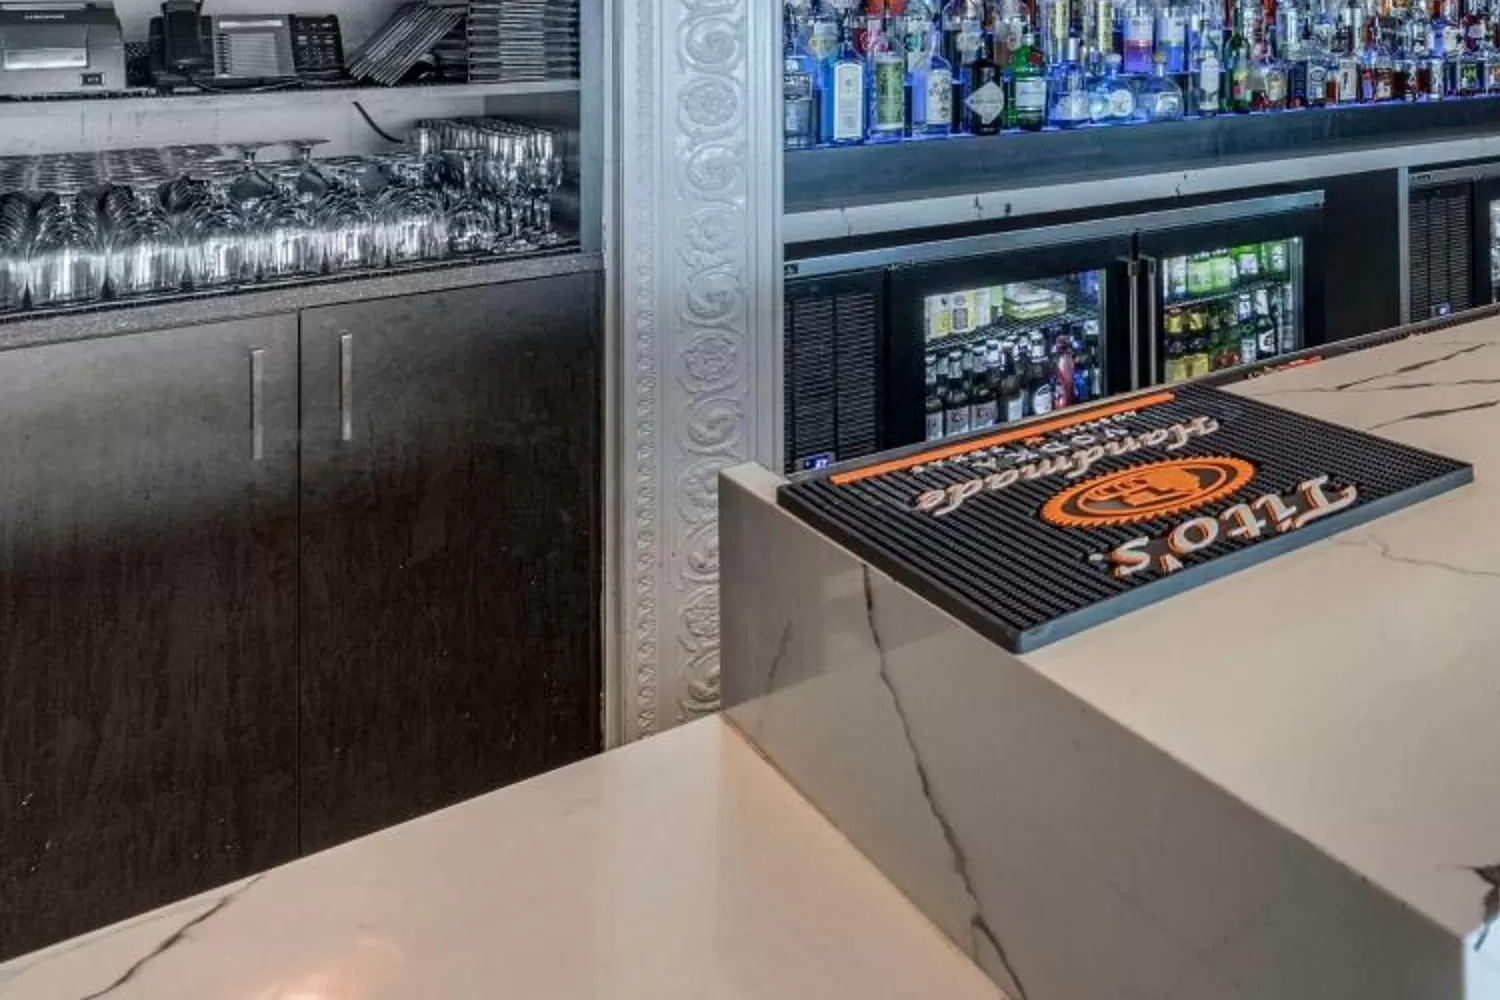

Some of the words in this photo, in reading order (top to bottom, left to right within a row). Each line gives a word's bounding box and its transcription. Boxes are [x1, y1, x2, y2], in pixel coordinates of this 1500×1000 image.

[916, 415, 1219, 517] Handmade
[971, 427, 1129, 469] VODKA
[1111, 475, 1358, 578] Tito's
